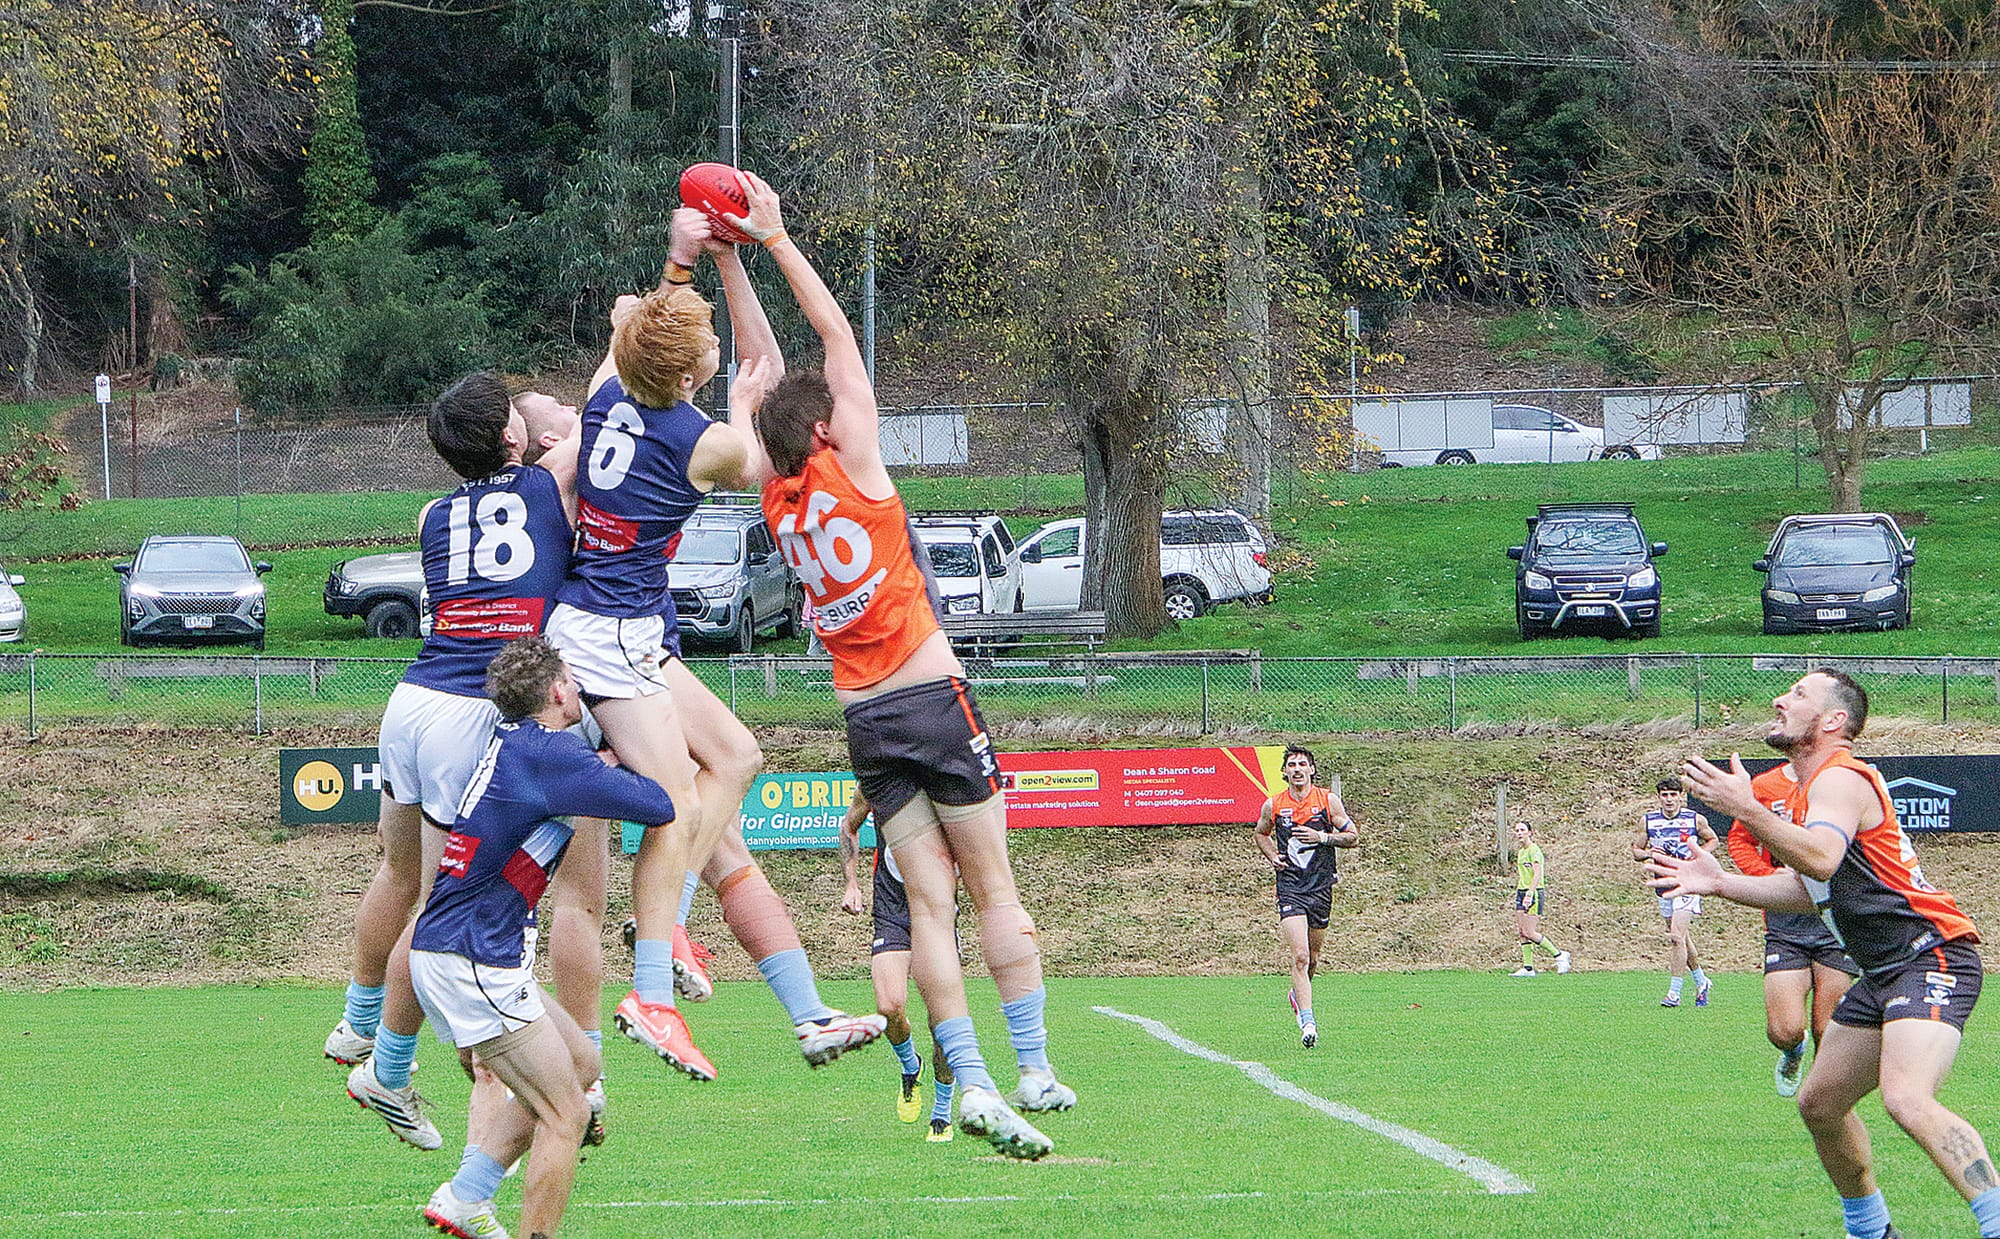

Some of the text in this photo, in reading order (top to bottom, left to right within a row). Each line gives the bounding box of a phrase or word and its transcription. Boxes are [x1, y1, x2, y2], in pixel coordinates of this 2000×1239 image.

[588, 402, 645, 490] 6
[489, 473, 516, 485] 1957
[446, 491, 535, 586] 18
[777, 490, 873, 597] 46
[827, 591, 870, 622] BURR
[498, 622, 535, 632] Bank
[352, 763, 381, 790] H
[1123, 766, 1216, 776] Dean & Sharon Goad
[298, 779, 339, 796] HU.
[1021, 775, 1093, 786] open2view.com
[761, 780, 857, 809] O'BRIE
[1134, 789, 1153, 797] 0407
[1154, 789, 1168, 797] 097
[1010, 801, 1032, 809] estate
[1032, 801, 1067, 810] marketing
[1068, 800, 1100, 808] solutions
[1134, 797, 1235, 808] dean.goad@open2view.com
[1893, 797, 1950, 815] STOM
[740, 813, 766, 830] for
[771, 812, 846, 832] Gippsla
[1897, 815, 1950, 828] LDING
[744, 835, 840, 846] .dannyobrienmp.com
